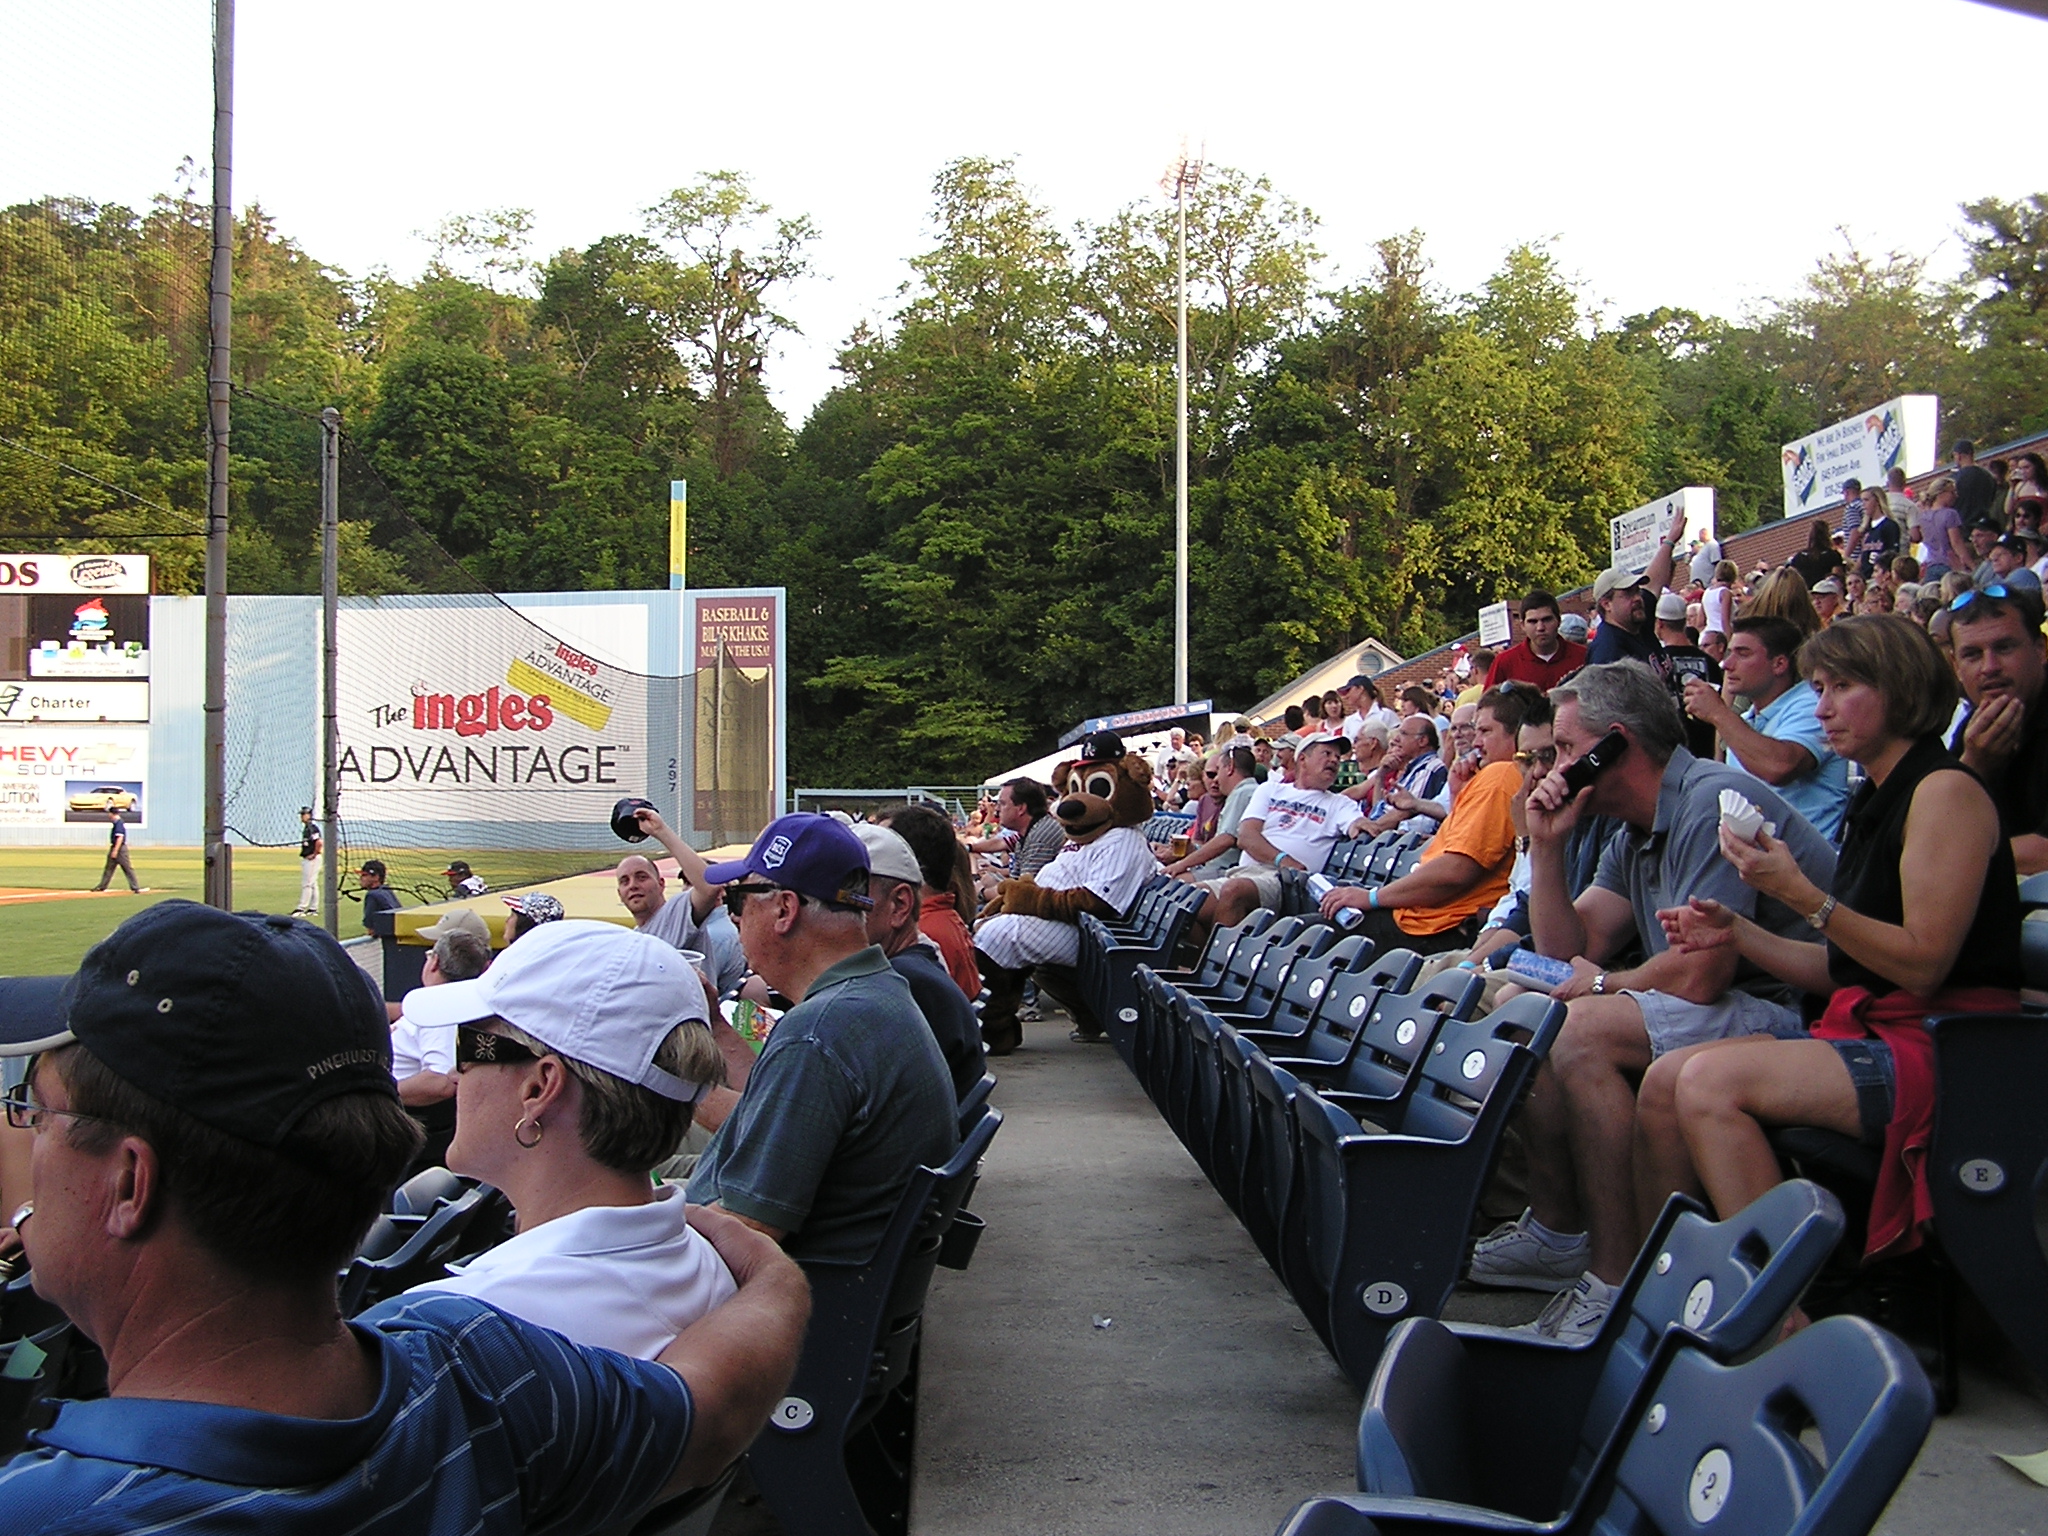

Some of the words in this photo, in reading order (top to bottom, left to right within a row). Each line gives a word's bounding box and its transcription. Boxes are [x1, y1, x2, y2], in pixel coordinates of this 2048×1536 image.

[702, 607, 759, 622] BASEBALL
[760, 607, 769, 621] &
[734, 645, 750, 657] THE
[751, 645, 770, 657] USA!
[524, 650, 609, 703] ADVANTAGE
[30, 696, 91, 708] Charter
[369, 704, 408, 728] The
[412, 685, 553, 737] ingles
[17, 764, 96, 776] SOUTH
[337, 746, 617, 784] ADVANTAGE
[668, 758, 677, 793] 297
[306, 1049, 377, 1080] PINEHURST
[1975, 1167, 1988, 1182] E
[1377, 1289, 1392, 1304] D
[1693, 1297, 1703, 1316] 1
[785, 1404, 798, 1420] C
[1701, 1471, 1717, 1501] 2
